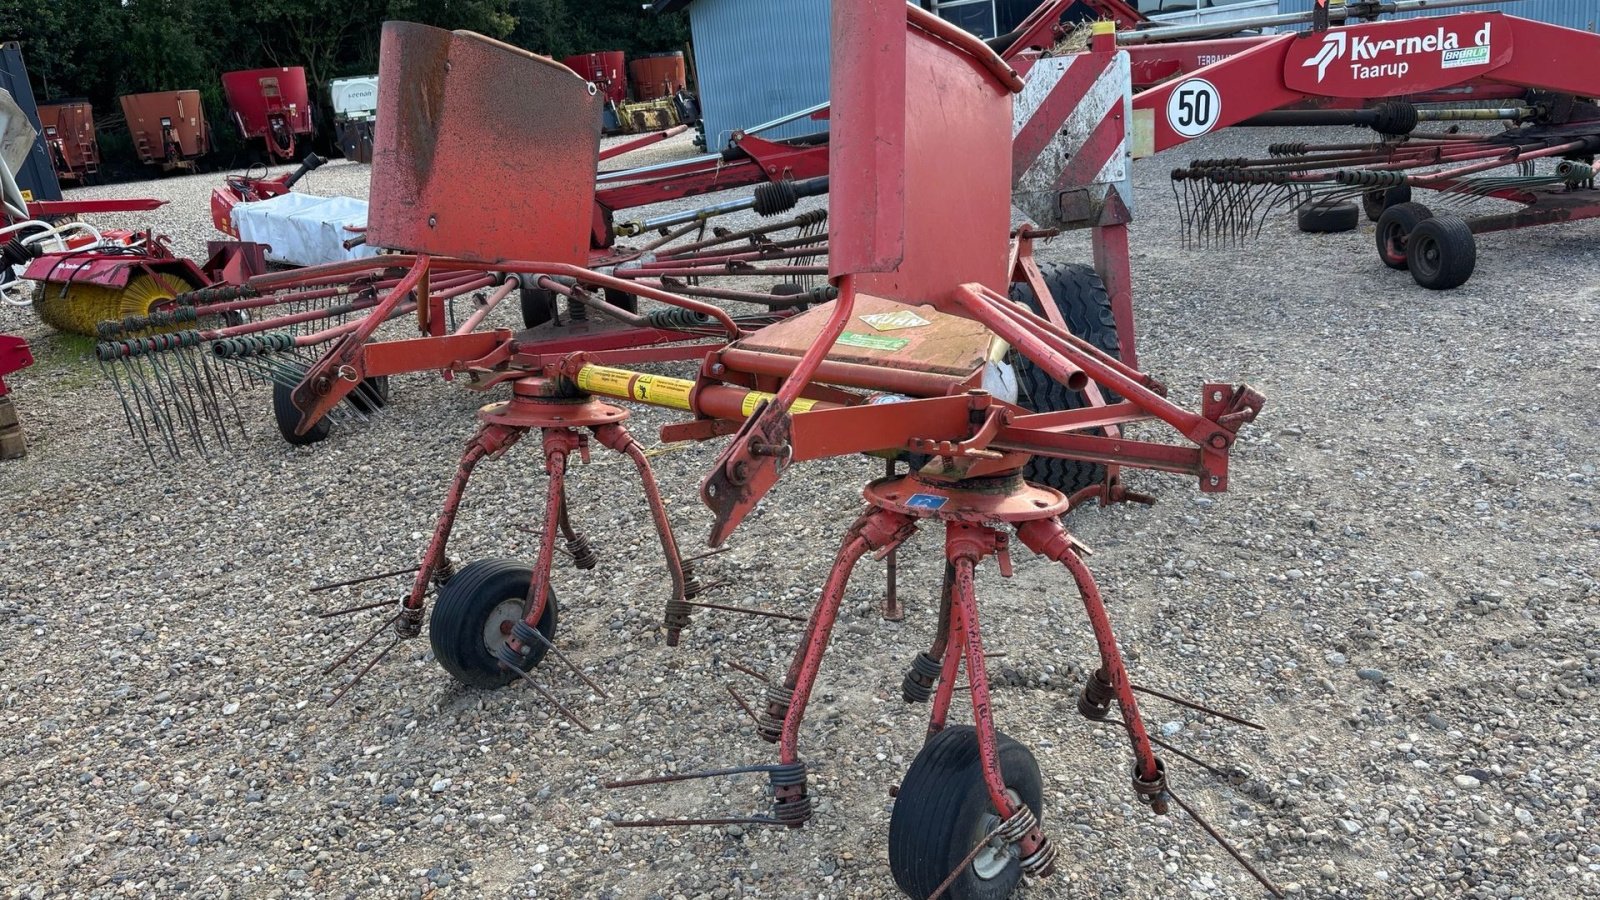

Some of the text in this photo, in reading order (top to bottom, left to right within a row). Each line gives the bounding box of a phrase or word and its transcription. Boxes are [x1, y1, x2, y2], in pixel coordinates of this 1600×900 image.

[1351, 22, 1491, 61] Kvernelad
[1351, 61, 1409, 80] Taarup
[1178, 89, 1211, 127] 50
